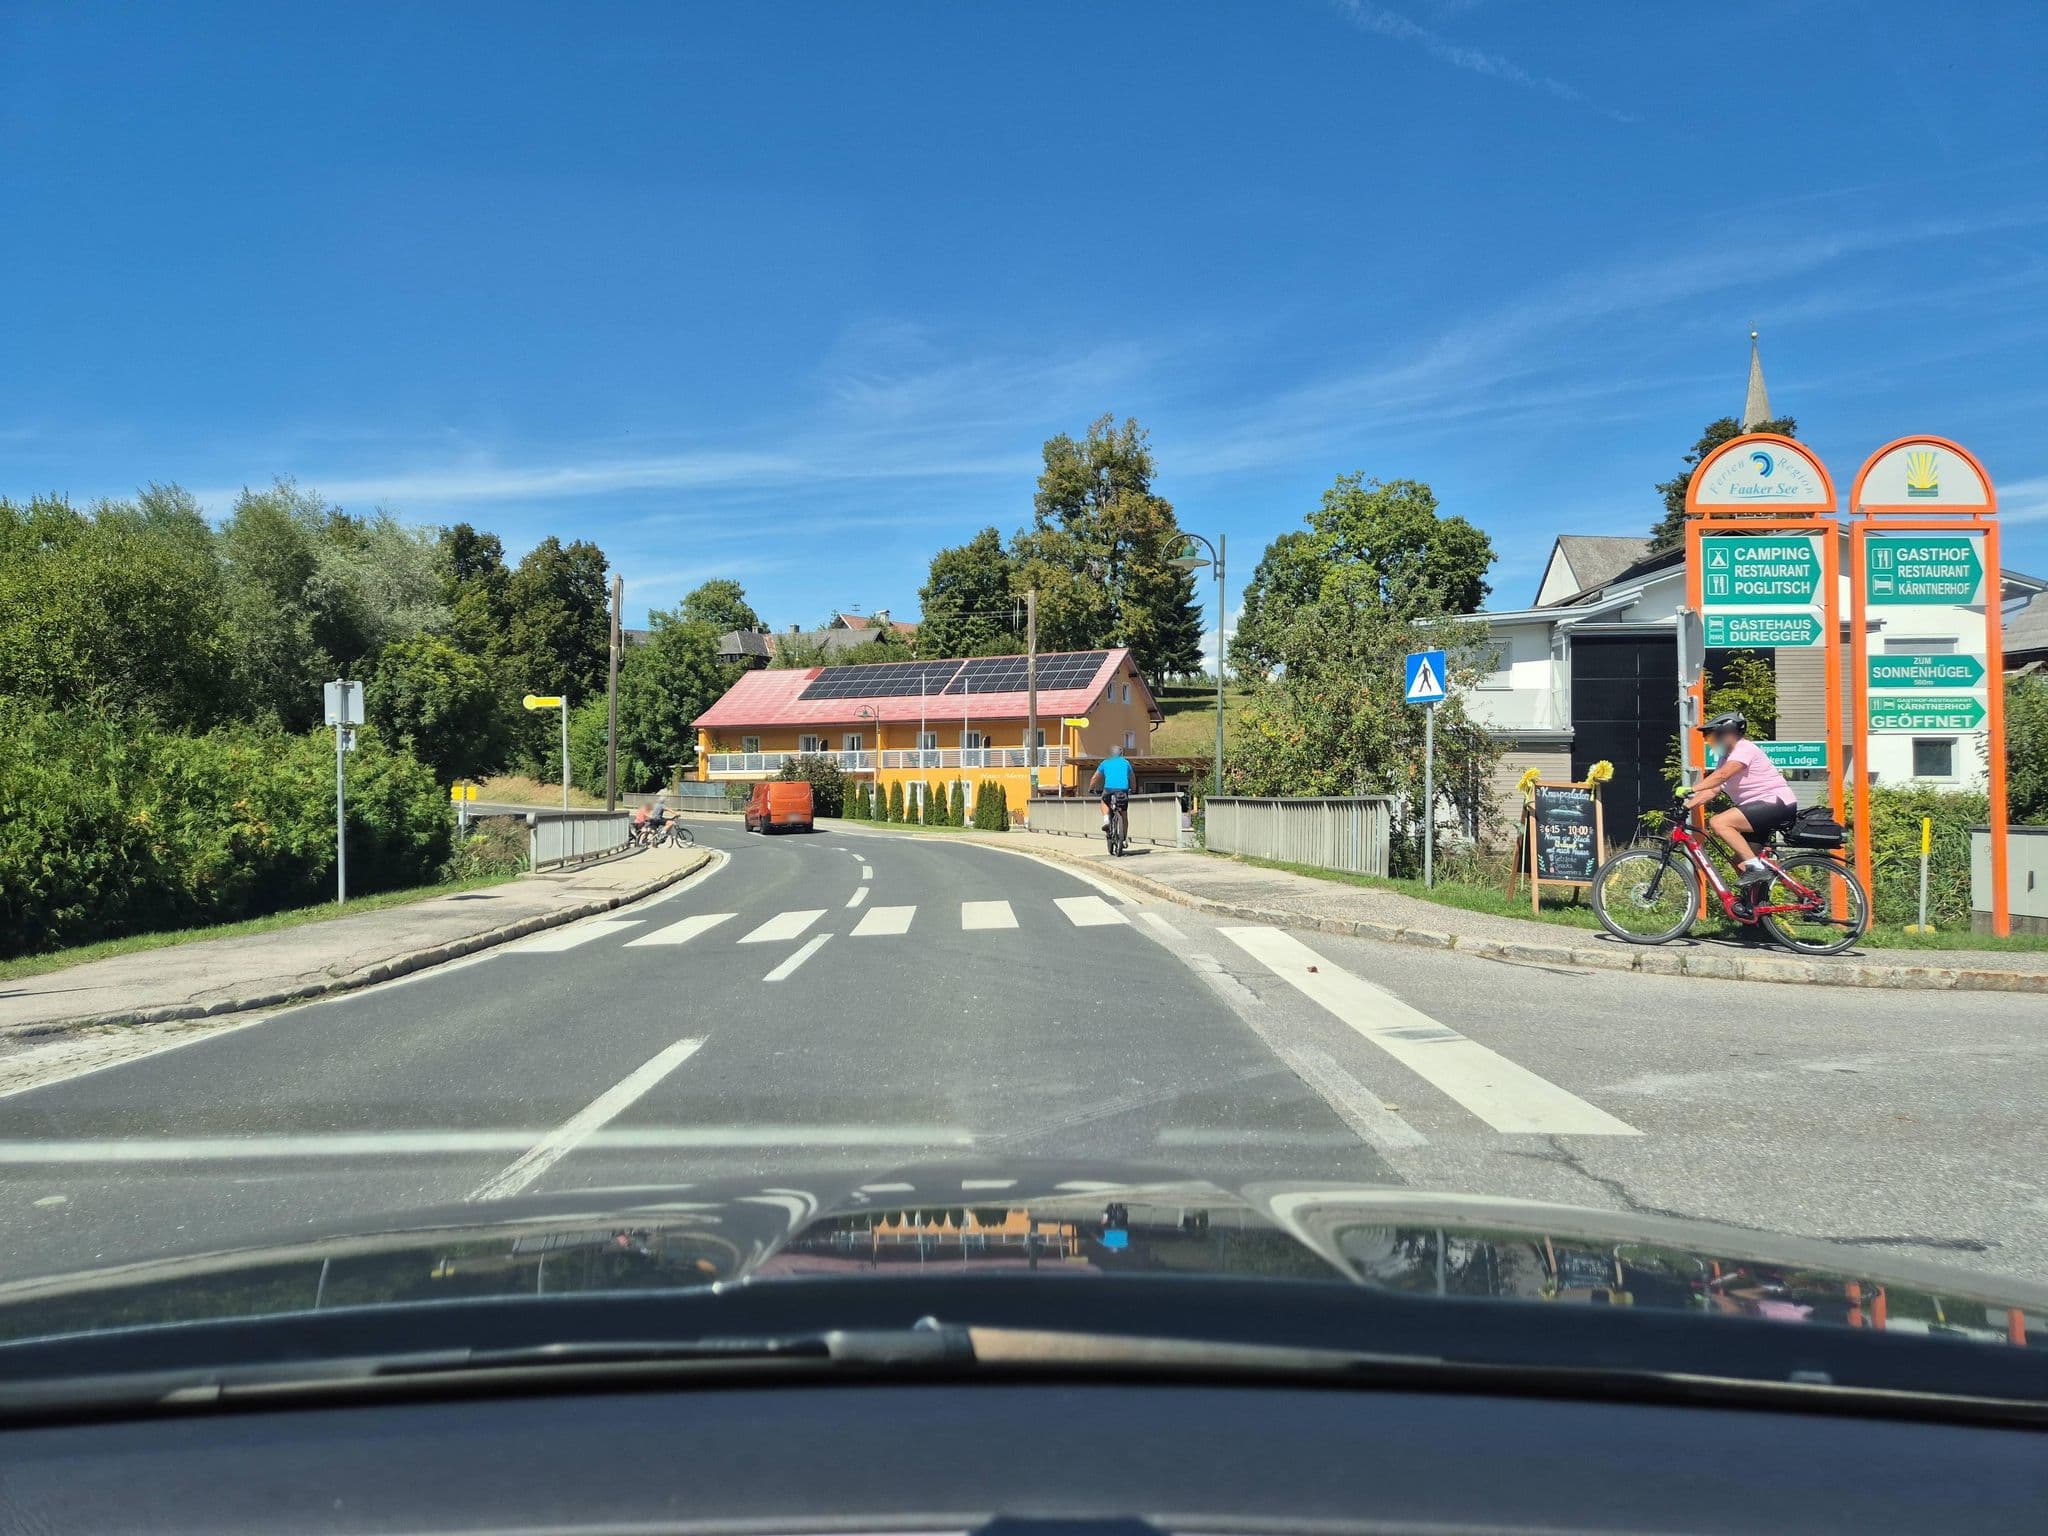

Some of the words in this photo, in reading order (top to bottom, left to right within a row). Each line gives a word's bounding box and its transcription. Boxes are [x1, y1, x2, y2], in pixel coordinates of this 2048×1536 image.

[1777, 457, 1814, 495] Region
[1730, 483, 1773, 495] Faaker
[1775, 483, 1798, 495] See
[1734, 548, 1810, 561] CAMPING
[1896, 548, 1970, 561] GASTHOF
[1734, 565, 1810, 577] RESTAURANT
[1898, 565, 1970, 577] RESTAURANT
[1735, 582, 1811, 595] POGLITSCH
[1898, 581, 1970, 595] KÄRNTNERHOF
[1729, 618, 1811, 630] GÄSTEHAUS
[1730, 631, 1811, 642] DUREGGER
[1913, 657, 1932, 665] ZUM
[1872, 664, 1973, 678] SONNENHÜGEL
[1897, 702, 1972, 710] KÄRNTNERHOF
[1871, 713, 1974, 728] GEÖFFNET
[1789, 756, 1818, 766] Lodge
